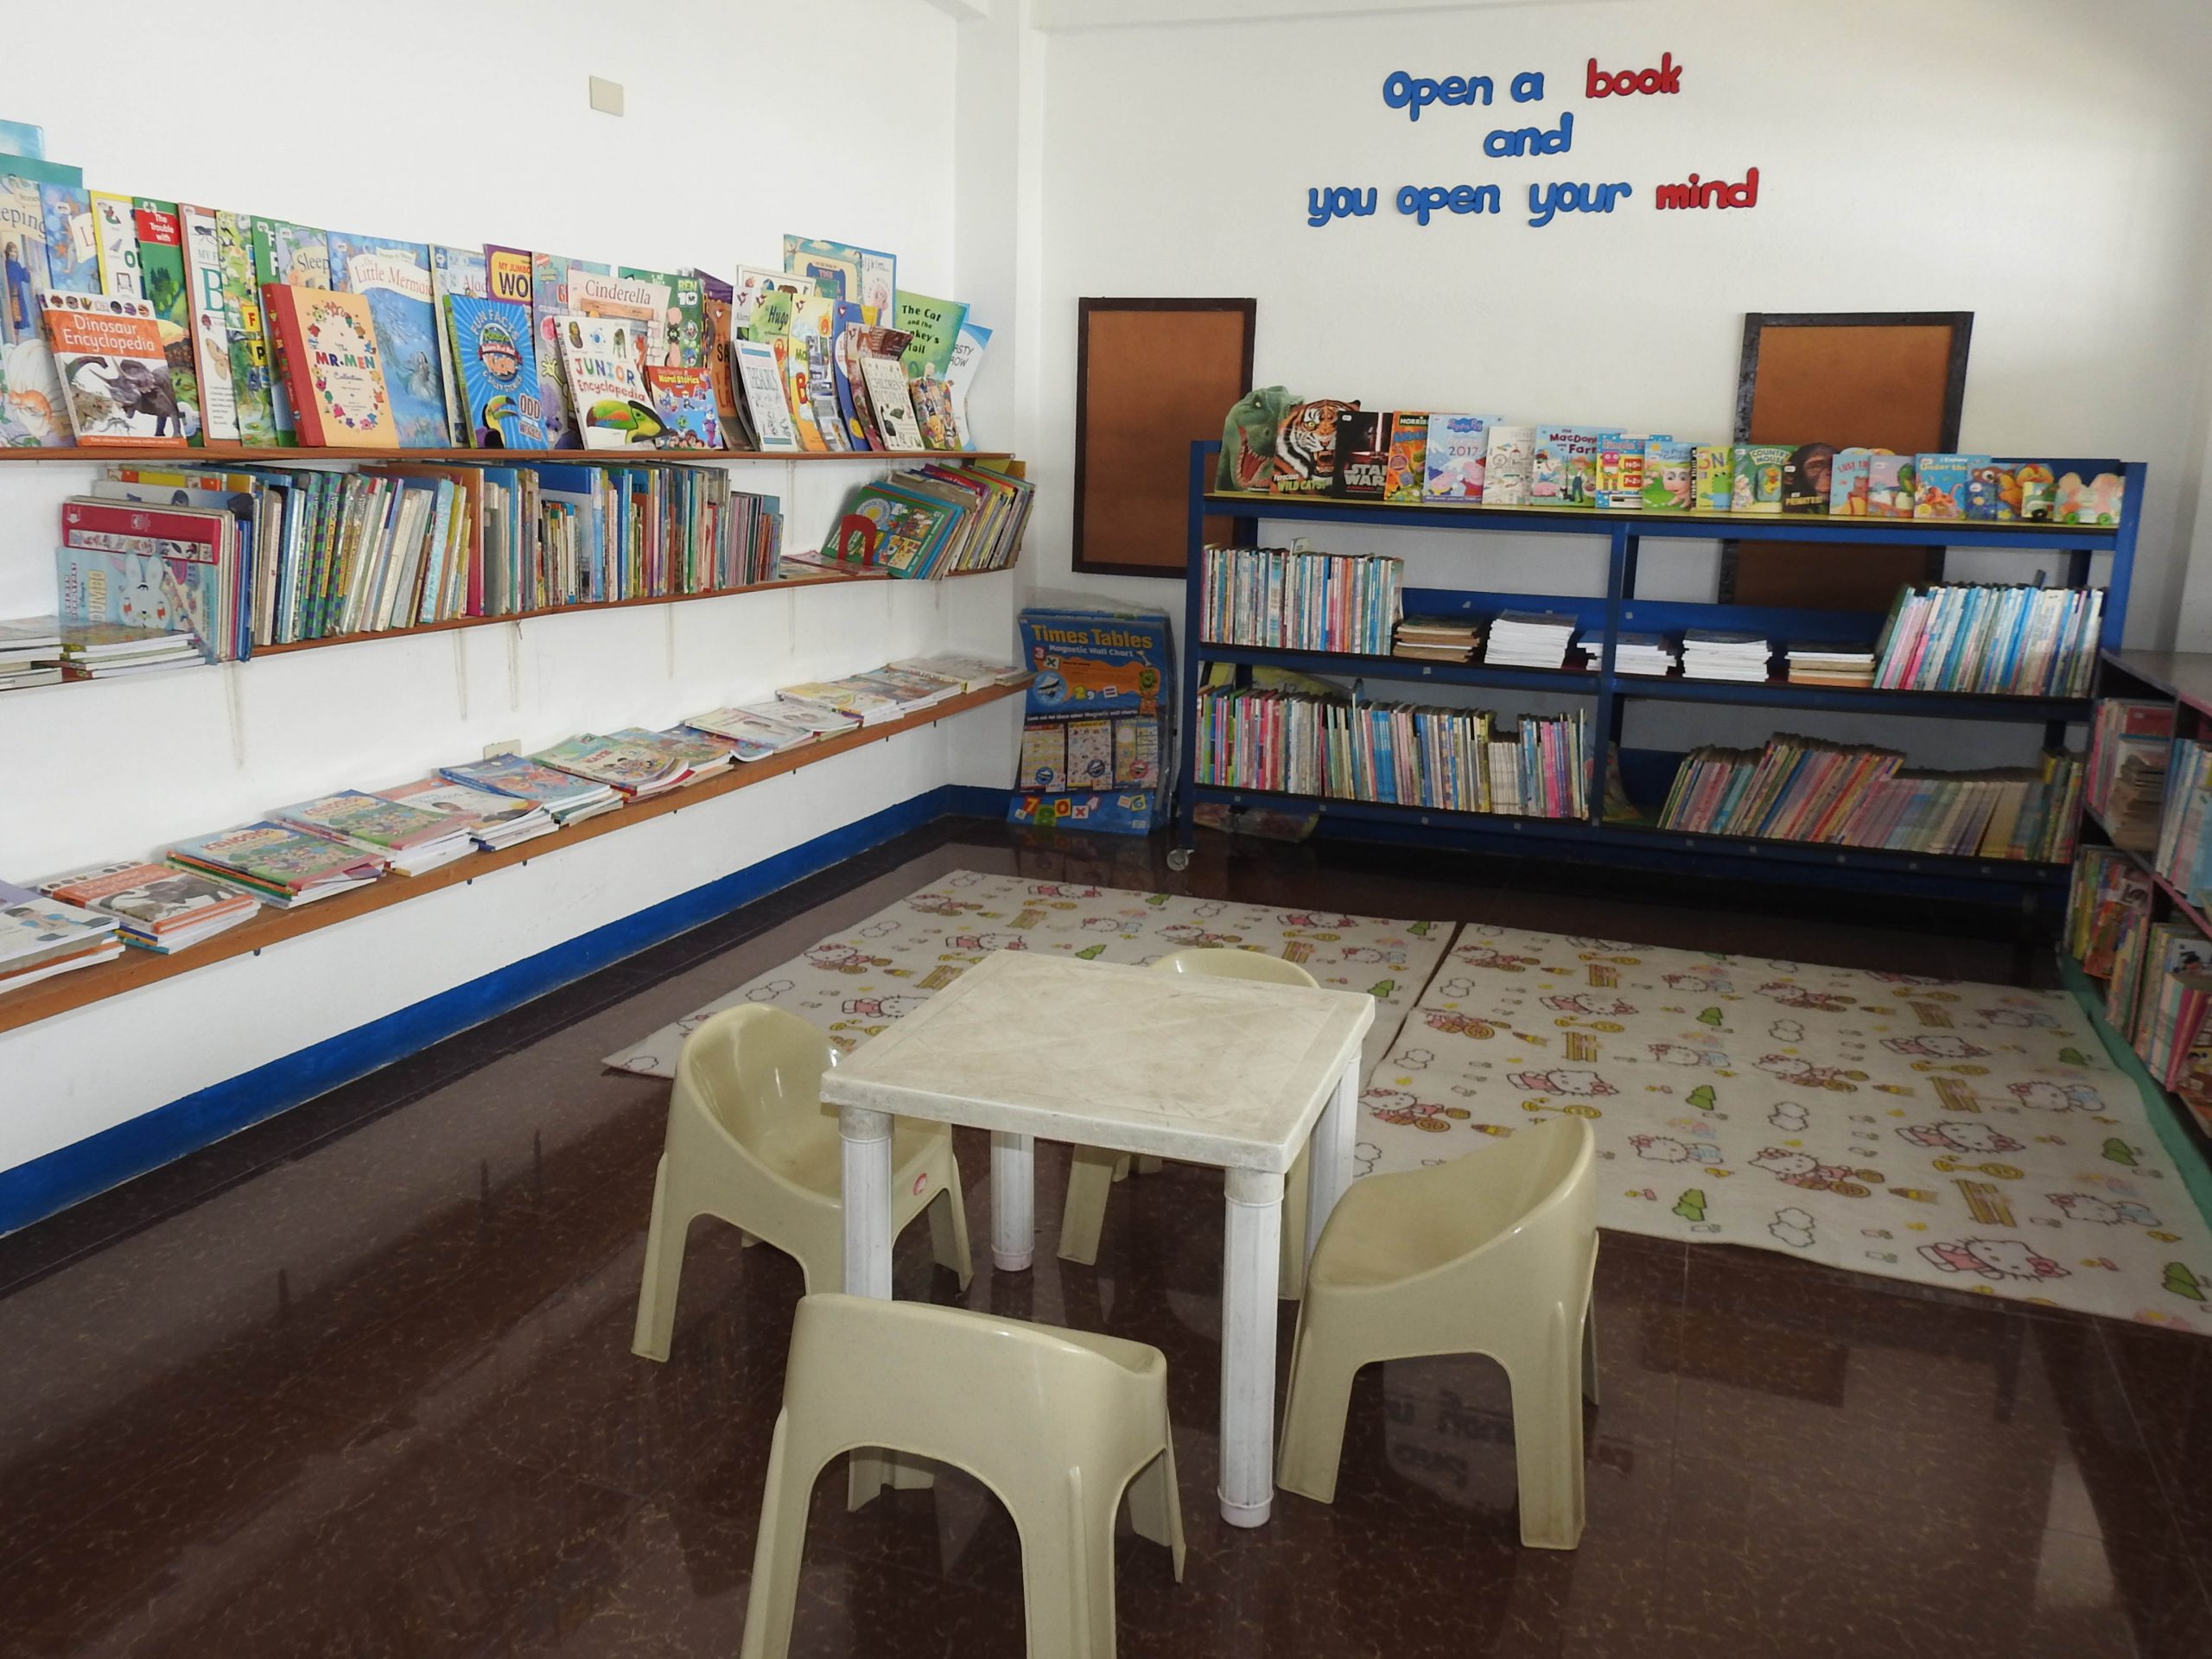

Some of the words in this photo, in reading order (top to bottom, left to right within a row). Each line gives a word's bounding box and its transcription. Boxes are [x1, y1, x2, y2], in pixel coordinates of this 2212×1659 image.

[1382, 71, 1494, 121] Open
[1510, 72, 1544, 102] a
[1586, 52, 1683, 99] book
[1483, 111, 1573, 157] and
[1307, 187, 1377, 227] you
[1396, 184, 1501, 226] open
[1528, 181, 1632, 227] your
[1656, 167, 1760, 210] mind
[149, 222, 175, 234] Trouble
[154, 213, 168, 223] The
[156, 233, 171, 242] with
[354, 263, 385, 283] Little
[585, 279, 651, 305] Cinderella
[677, 292, 697, 306] 10
[901, 305, 921, 315] The
[924, 308, 942, 321] Cat
[73, 314, 138, 335] Dinosaur
[470, 312, 488, 334] FUN
[488, 309, 520, 341] FACTS
[921, 320, 932, 329] the
[62, 329, 156, 354] Encyclopedia
[906, 330, 940, 344] nkey's
[908, 343, 925, 354] Tail
[574, 357, 635, 386] JUNIOR
[577, 379, 645, 402] Encyclopedia
[520, 395, 541, 420] ODD
[1448, 446, 1478, 456] 2017
[1277, 480, 1299, 491] WILD
[89, 569, 106, 622] DUMBO
[1031, 625, 1089, 645] Times
[1090, 628, 1154, 649] Tables
[1049, 645, 1088, 655] Magnetic
[1089, 647, 1107, 656] Wall
[1109, 648, 1135, 658] Chart
